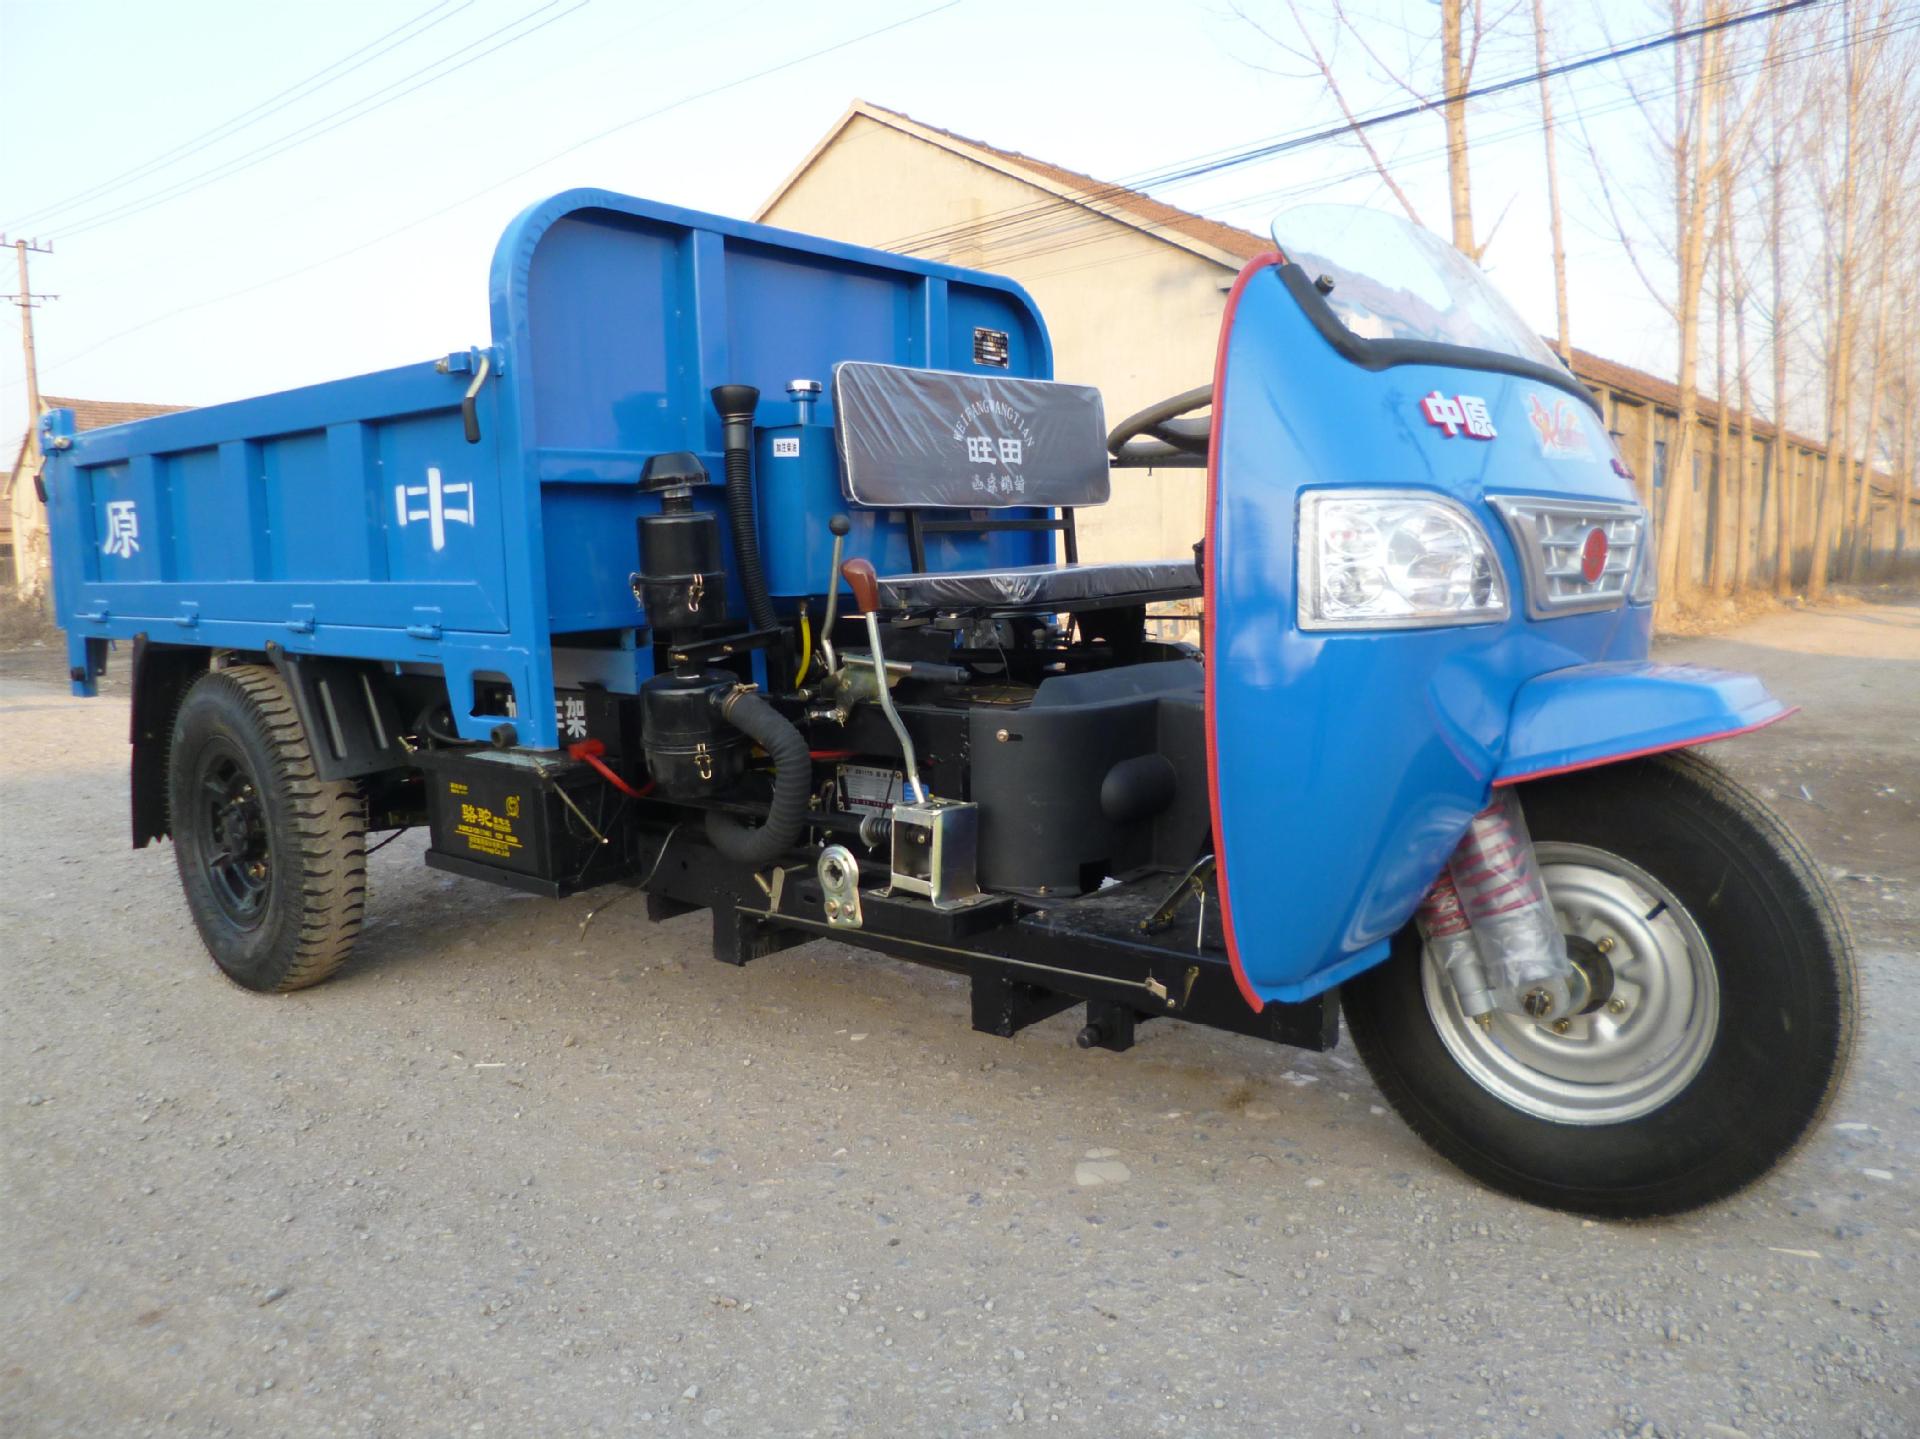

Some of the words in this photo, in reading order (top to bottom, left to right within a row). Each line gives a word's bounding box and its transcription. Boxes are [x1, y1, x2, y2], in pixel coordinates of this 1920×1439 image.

[1421, 390, 1497, 440] 中原
[966, 436, 1022, 465] 旺田
[104, 501, 140, 558] 原
[395, 467, 474, 551] 中
